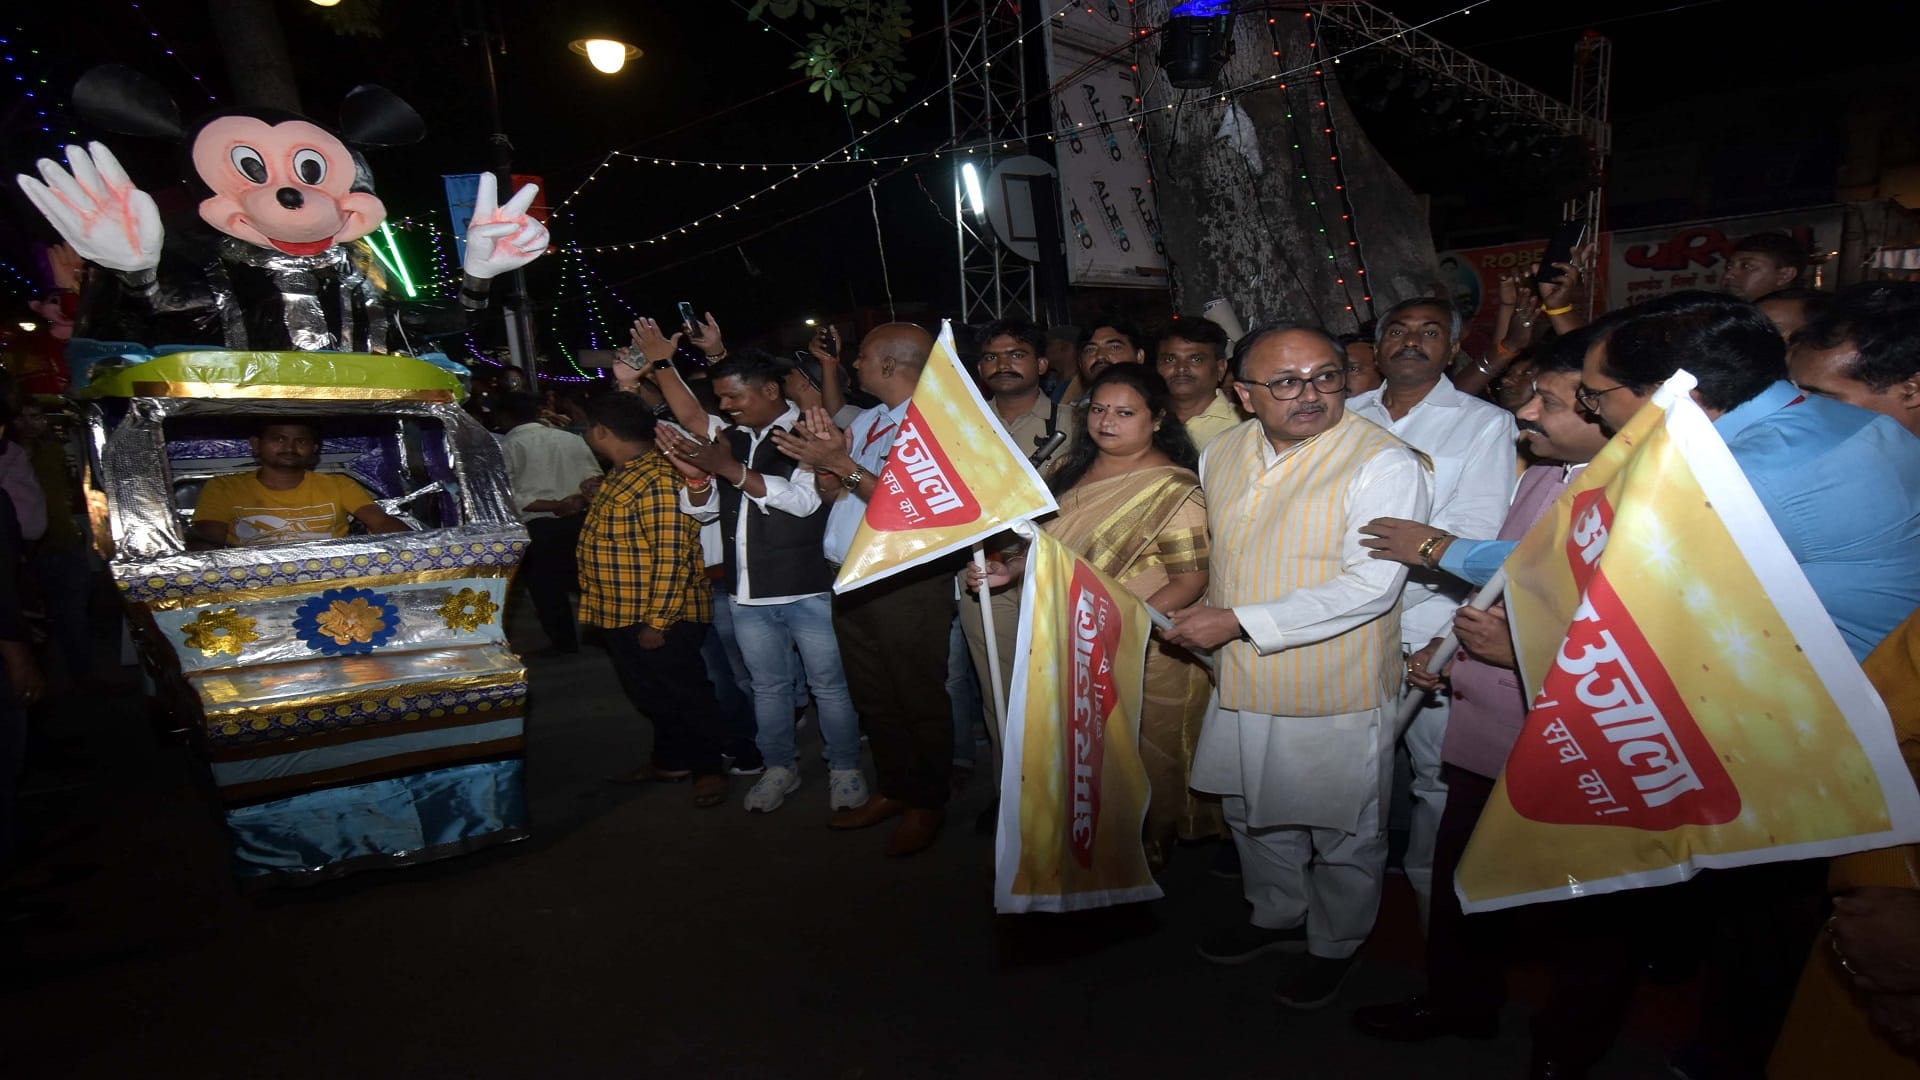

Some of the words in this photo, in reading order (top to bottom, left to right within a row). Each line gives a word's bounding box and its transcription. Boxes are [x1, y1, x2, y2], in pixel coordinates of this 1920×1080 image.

[1093, 180, 1130, 252] ALDEKO
[892, 422, 964, 515] उजाला
[1074, 584, 1098, 727] उजाला
[1543, 717, 1587, 764] सच
[1577, 769, 1629, 817] का!
[1557, 629, 1704, 808] उजाला
[1072, 728, 1092, 850] अमर
